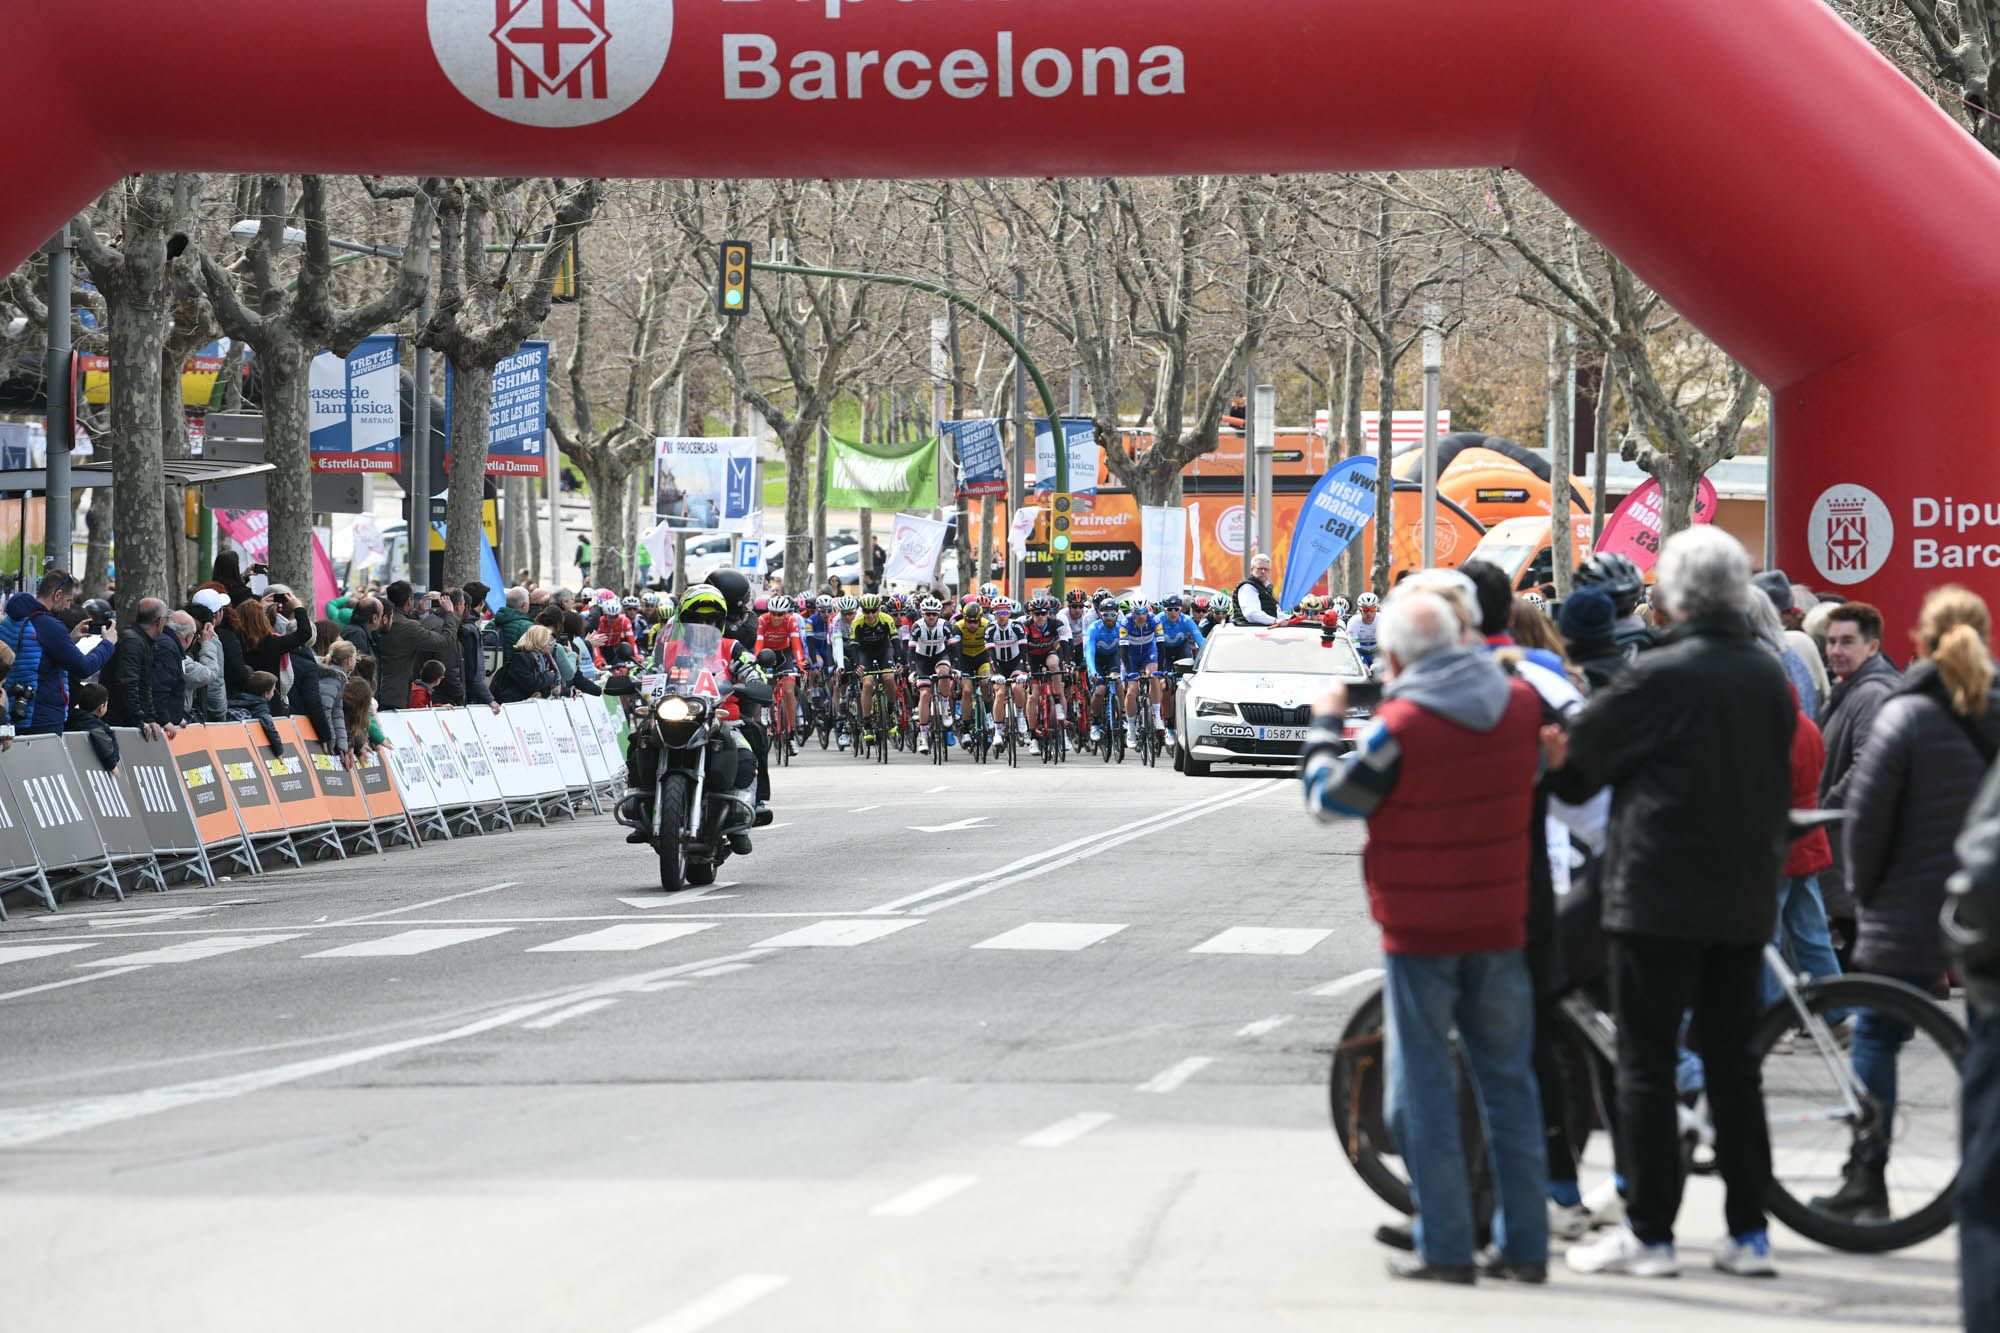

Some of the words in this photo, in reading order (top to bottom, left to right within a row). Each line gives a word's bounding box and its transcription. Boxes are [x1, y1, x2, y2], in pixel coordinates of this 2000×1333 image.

[722, 31, 1186, 100] Barcelona
[351, 347, 393, 370] TRETZÈ
[493, 351, 542, 376] SPELSONS
[491, 368, 540, 393] ISHIMA
[352, 386, 369, 399] de
[490, 397, 513, 411] AWN
[515, 390, 540, 405] AMOS
[499, 384, 540, 400] REVEREND
[316, 401, 394, 414] lamúsica
[500, 411, 510, 423] DE
[511, 405, 523, 420] LES
[524, 401, 539, 416] ARTS
[319, 457, 359, 469] Estrella
[361, 458, 393, 469] Damm
[485, 460, 505, 471] rella
[506, 461, 539, 472] Damm
[1329, 480, 1364, 506] visit
[1071, 513, 1127, 526] rained!
[1314, 492, 1370, 527] mataro
[1320, 517, 1355, 541] .cat
[1630, 530, 1660, 554] .ca
[743, 544, 758, 565] P
[1038, 550, 1126, 562] NAEDSPORT
[1913, 539, 2000, 568] Barc
[1047, 564, 1105, 572] SERFOOD
[651, 687, 662, 697] 45
[693, 671, 719, 697] A
[1211, 724, 1253, 737] ŠKODA
[1266, 728, 1290, 739] 0587
[23, 773, 84, 828] GOBIK
